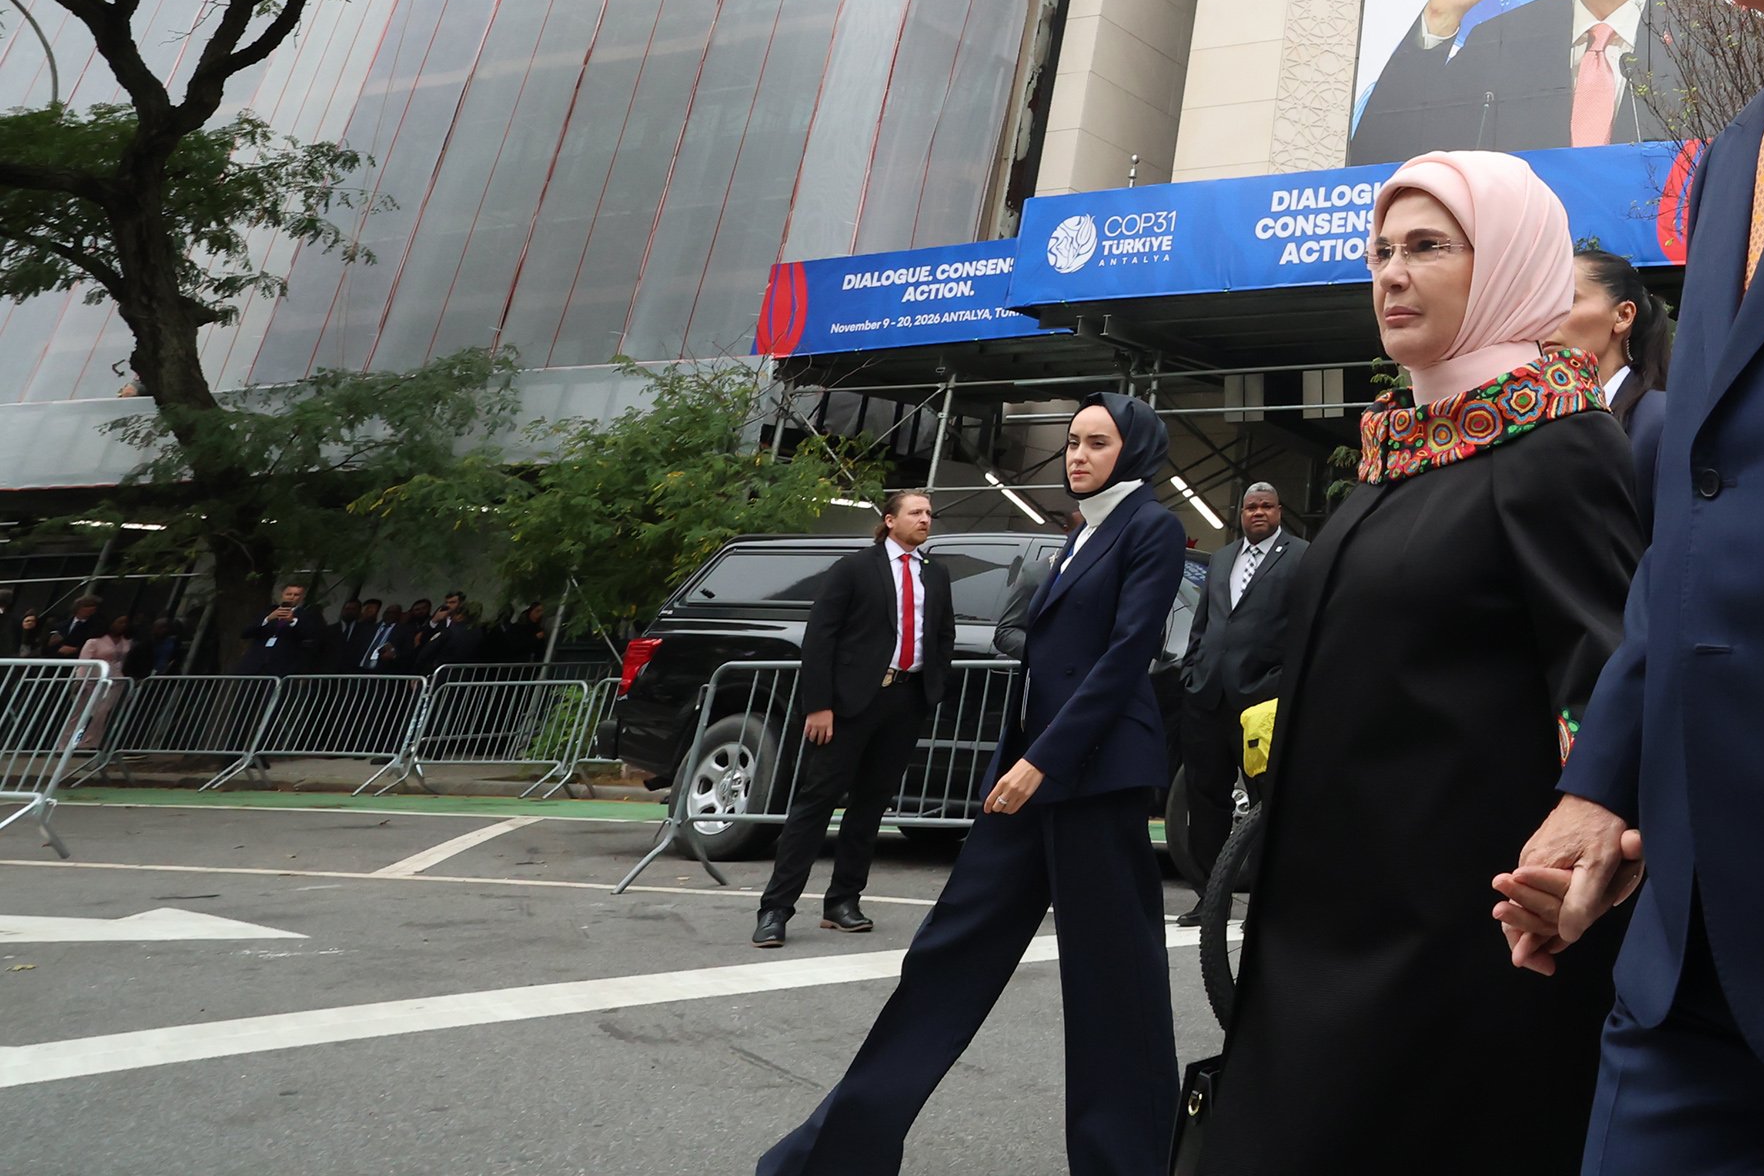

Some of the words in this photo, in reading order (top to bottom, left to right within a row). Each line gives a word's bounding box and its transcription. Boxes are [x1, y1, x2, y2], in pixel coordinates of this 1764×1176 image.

[1104, 210, 1177, 237] COP31
[1098, 254, 1170, 267] ANTALYA
[1279, 237, 1370, 265] ACTIO
[842, 270, 933, 290] DIALOGUE.
[901, 281, 975, 303] ACTION.
[830, 320, 882, 334] November
[883, 317, 890, 329] 9
[896, 316, 914, 329] 20,
[914, 315, 940, 327] 2026
[941, 309, 993, 323] ANTALYA,
